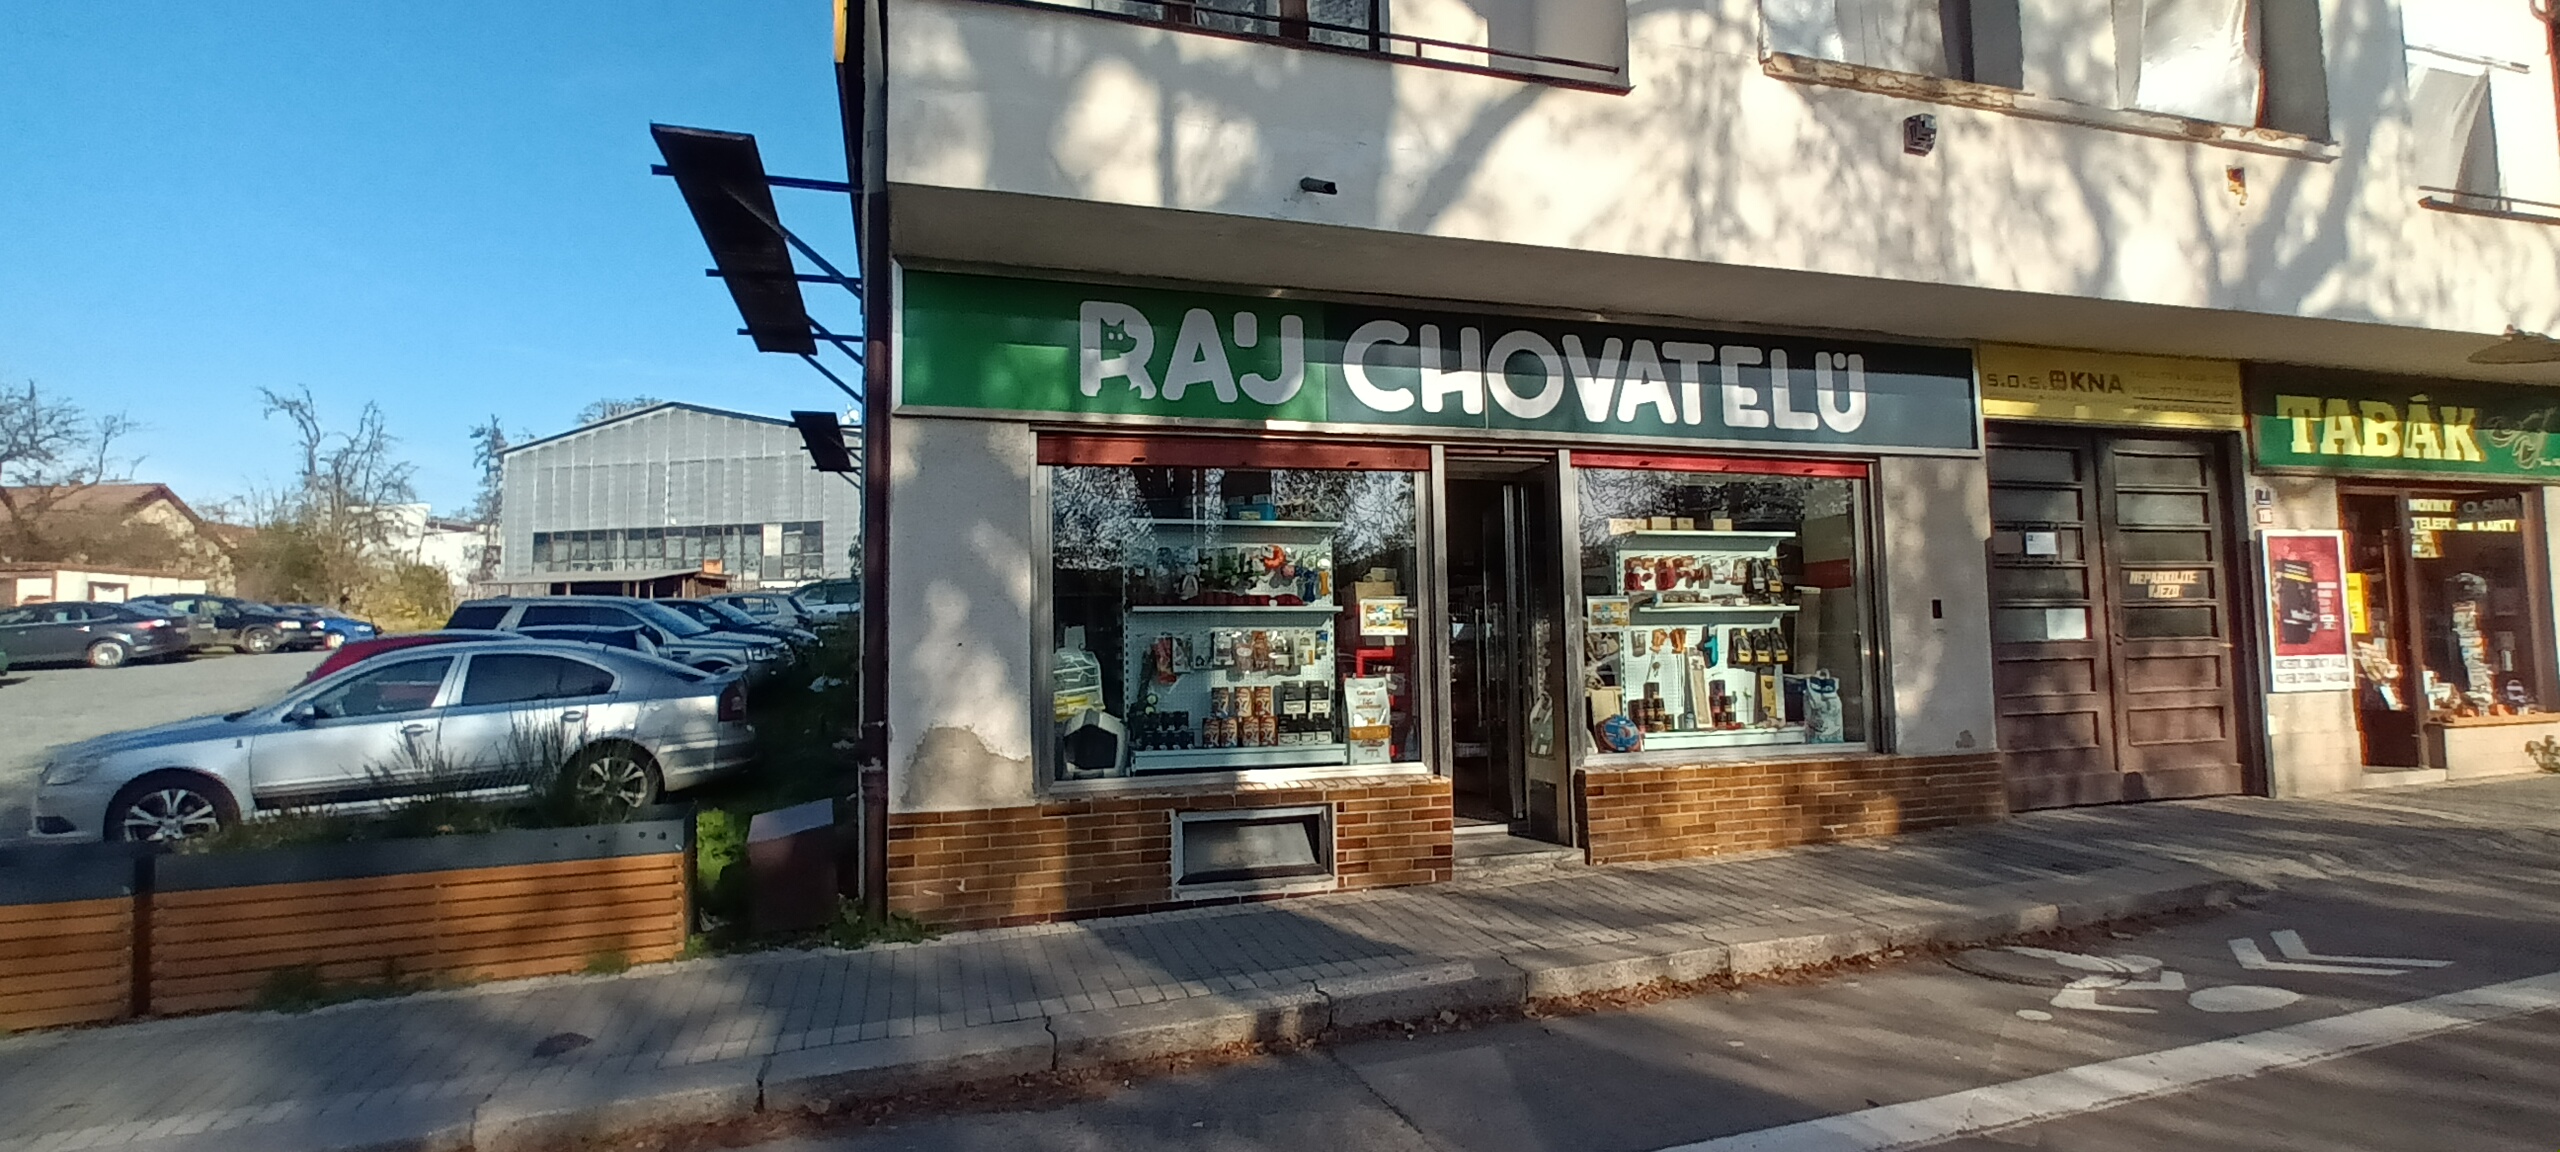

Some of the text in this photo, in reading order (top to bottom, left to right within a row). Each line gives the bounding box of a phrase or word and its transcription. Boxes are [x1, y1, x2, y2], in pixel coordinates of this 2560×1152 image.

[1343, 320, 1867, 433] CHOVATELŮ
[2048, 370, 2125, 393] OKNA
[2276, 394, 2486, 462] TABÁK
[2481, 497, 2517, 512] SIM
